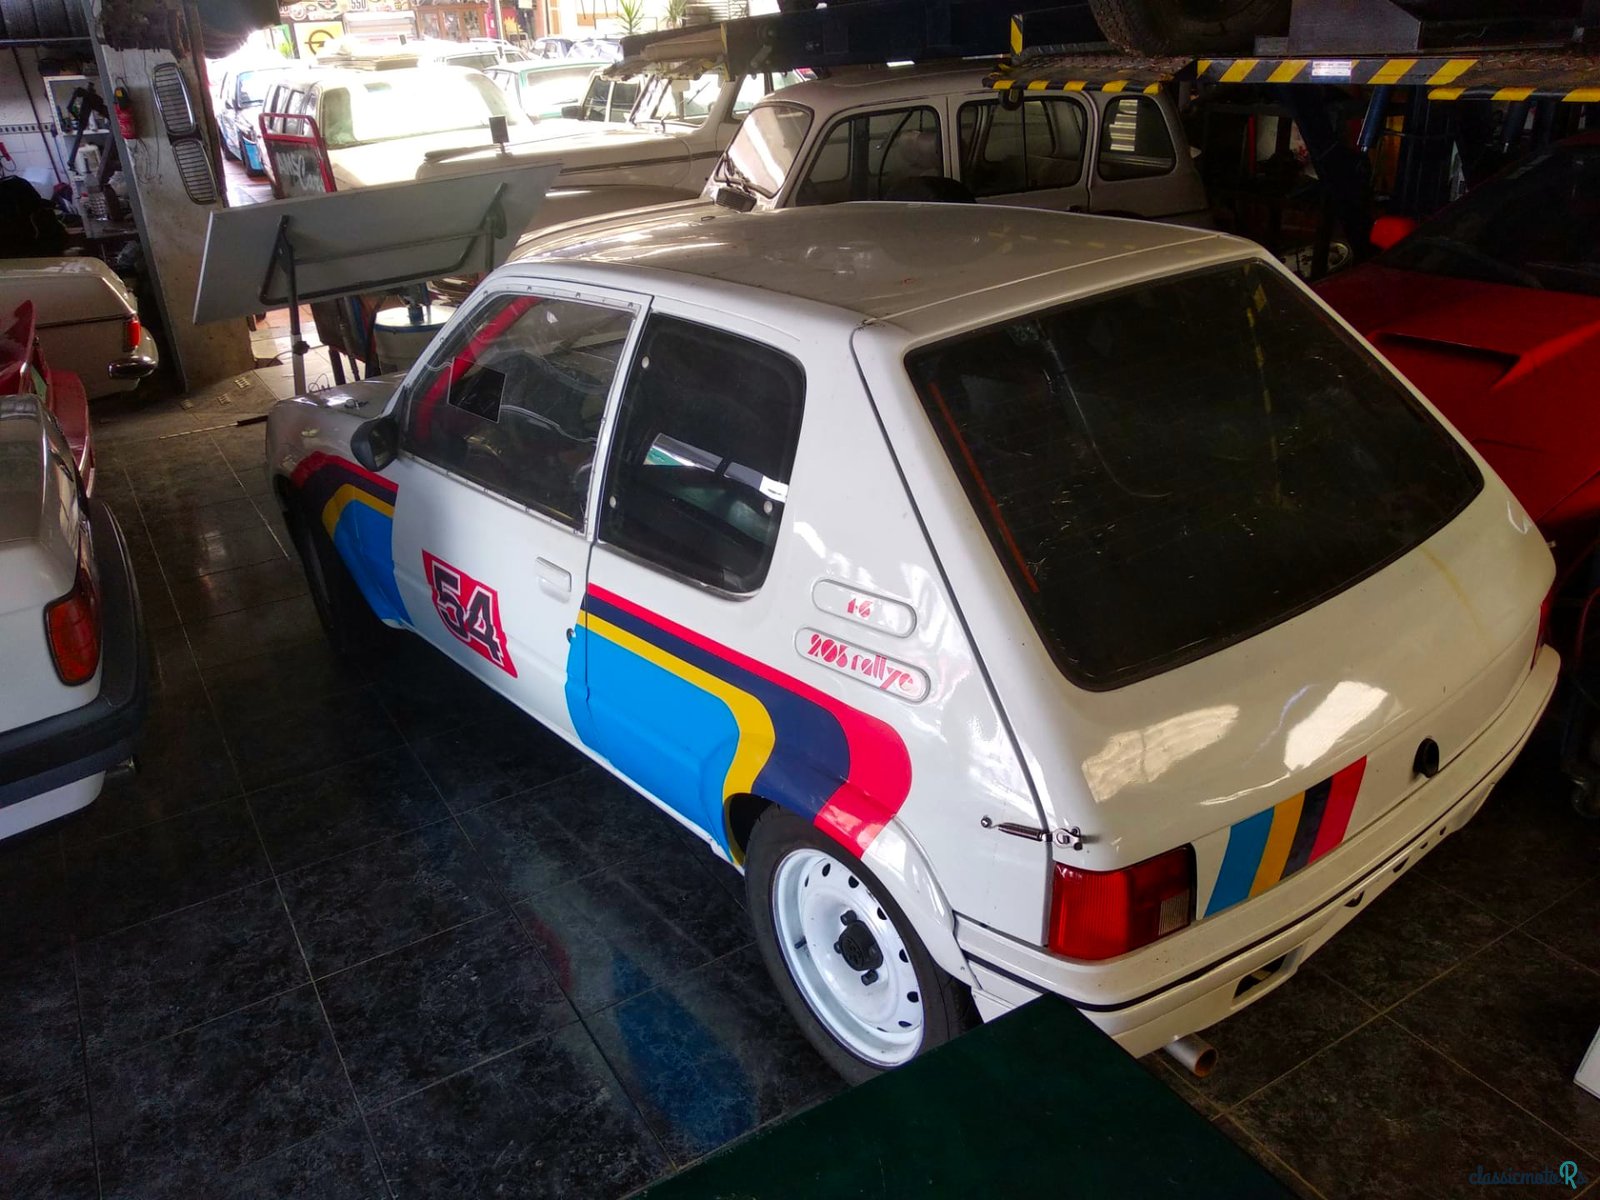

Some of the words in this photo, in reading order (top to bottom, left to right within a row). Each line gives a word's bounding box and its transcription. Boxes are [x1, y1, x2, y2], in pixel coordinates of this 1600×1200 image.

[432, 560, 505, 667] 54
[807, 633, 848, 668] 205
[850, 654, 914, 691] rallye
